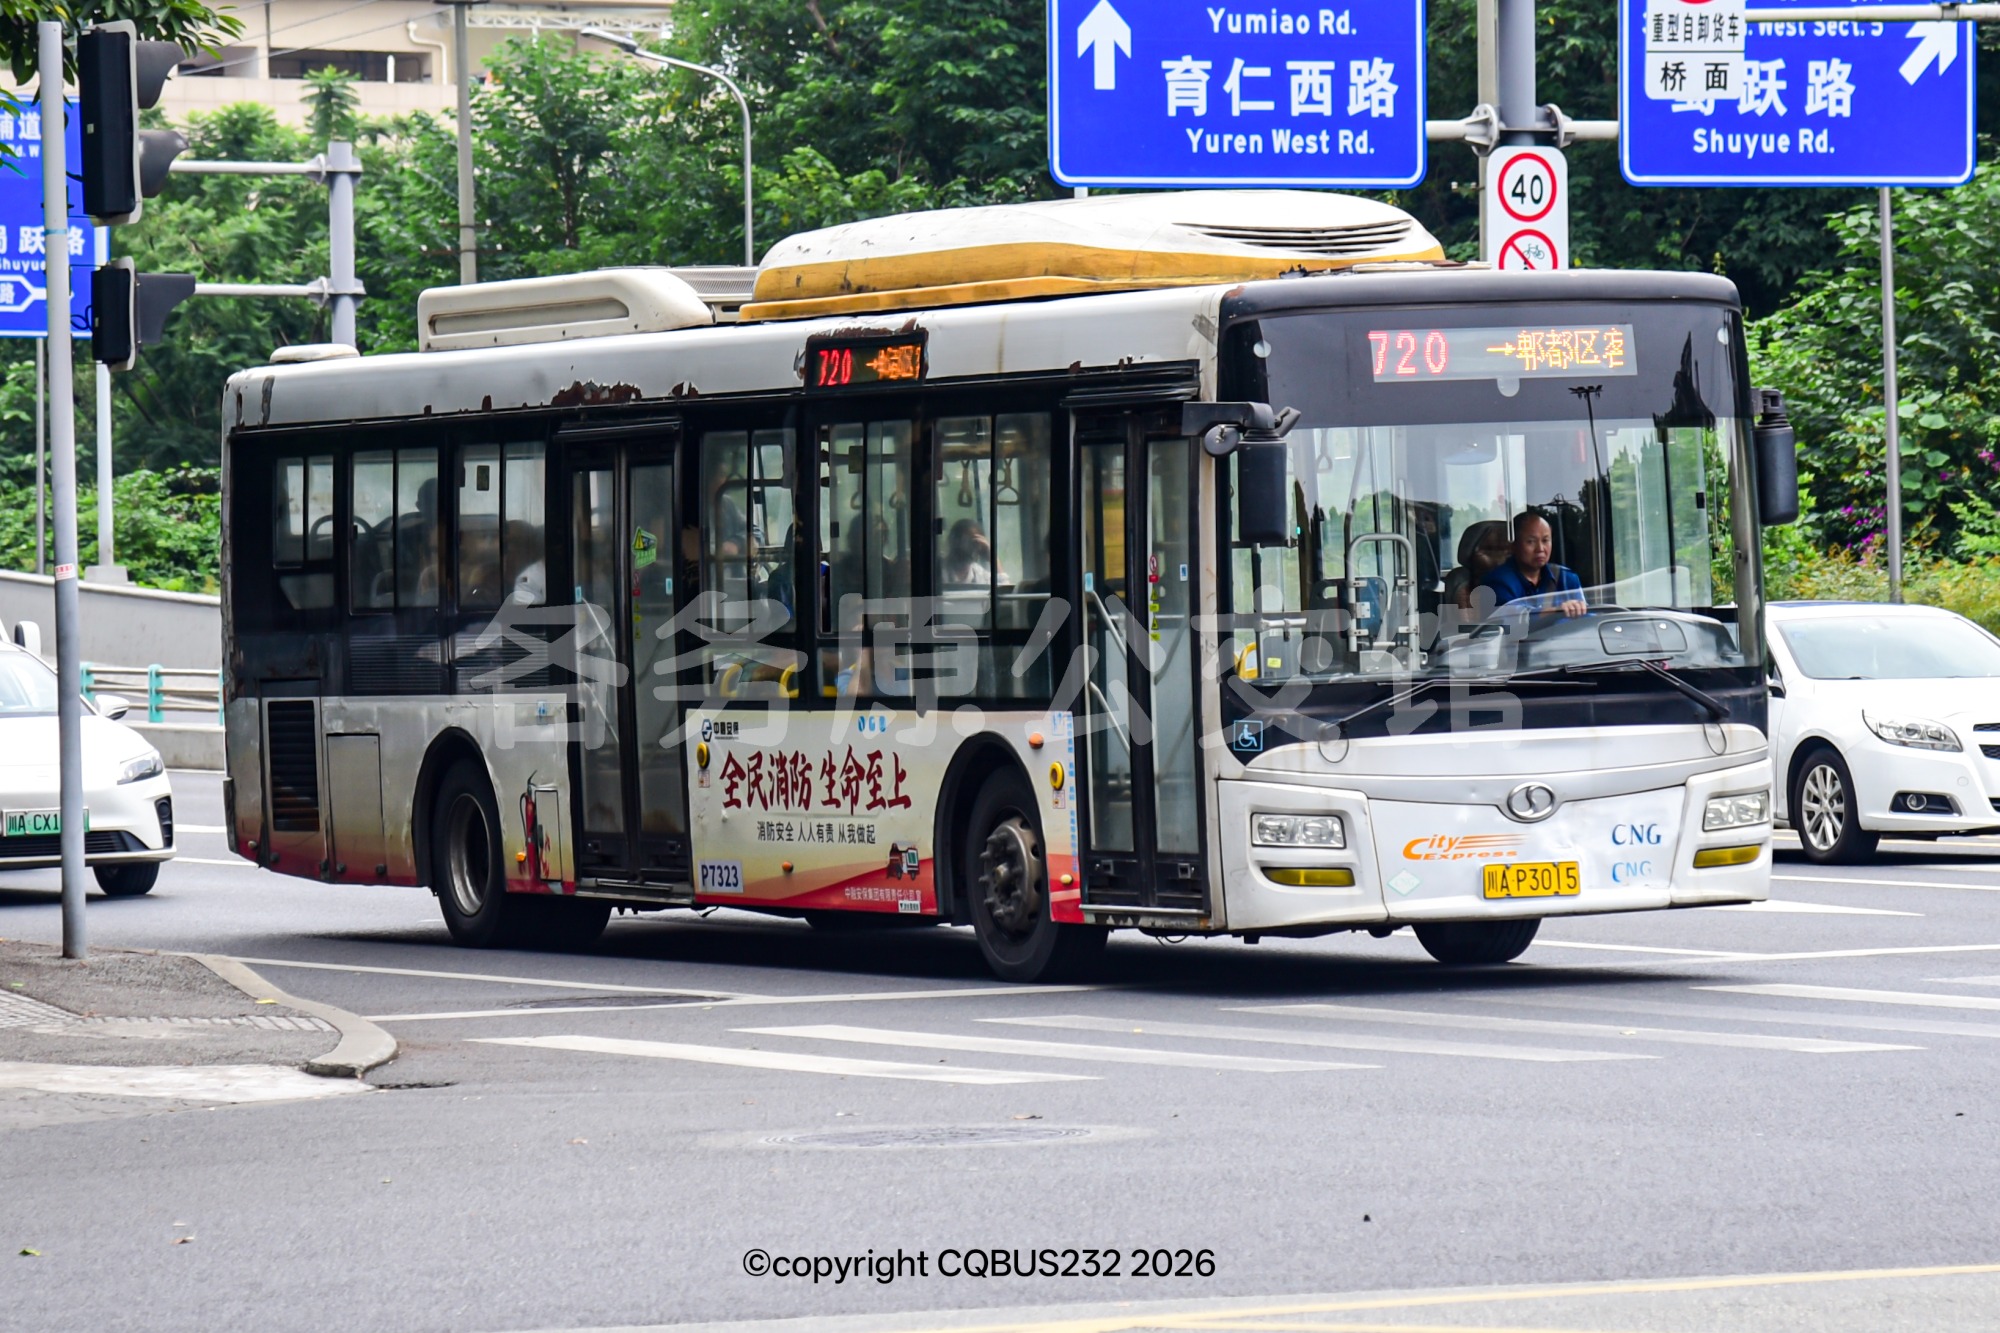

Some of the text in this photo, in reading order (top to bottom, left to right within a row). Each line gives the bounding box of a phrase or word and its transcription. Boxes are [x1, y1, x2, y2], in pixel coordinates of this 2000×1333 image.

[1207, 8, 1357, 34] Yumiao Rd.
[1652, 12, 1739, 43] 重型自卸货车
[1161, 55, 1399, 118] 育仁西路
[1660, 61, 1729, 92] 桥面
[1187, 128, 1375, 154] Yuren West Rd.
[1693, 128, 1835, 159] Shuyue Rd.
[1511, 174, 1543, 205] 40
[818, 348, 852, 386] 720
[1369, 330, 1447, 375] 720
[719, 744, 912, 816] 全民消防 生命至上
[757, 820, 876, 844] 消防安全 人人有责 从我做起
[1612, 823, 1662, 846] CNG
[1402, 834, 1460, 861] City
[1423, 850, 1518, 861] Express
[701, 864, 739, 887] P7323
[1612, 860, 1652, 883] CNG
